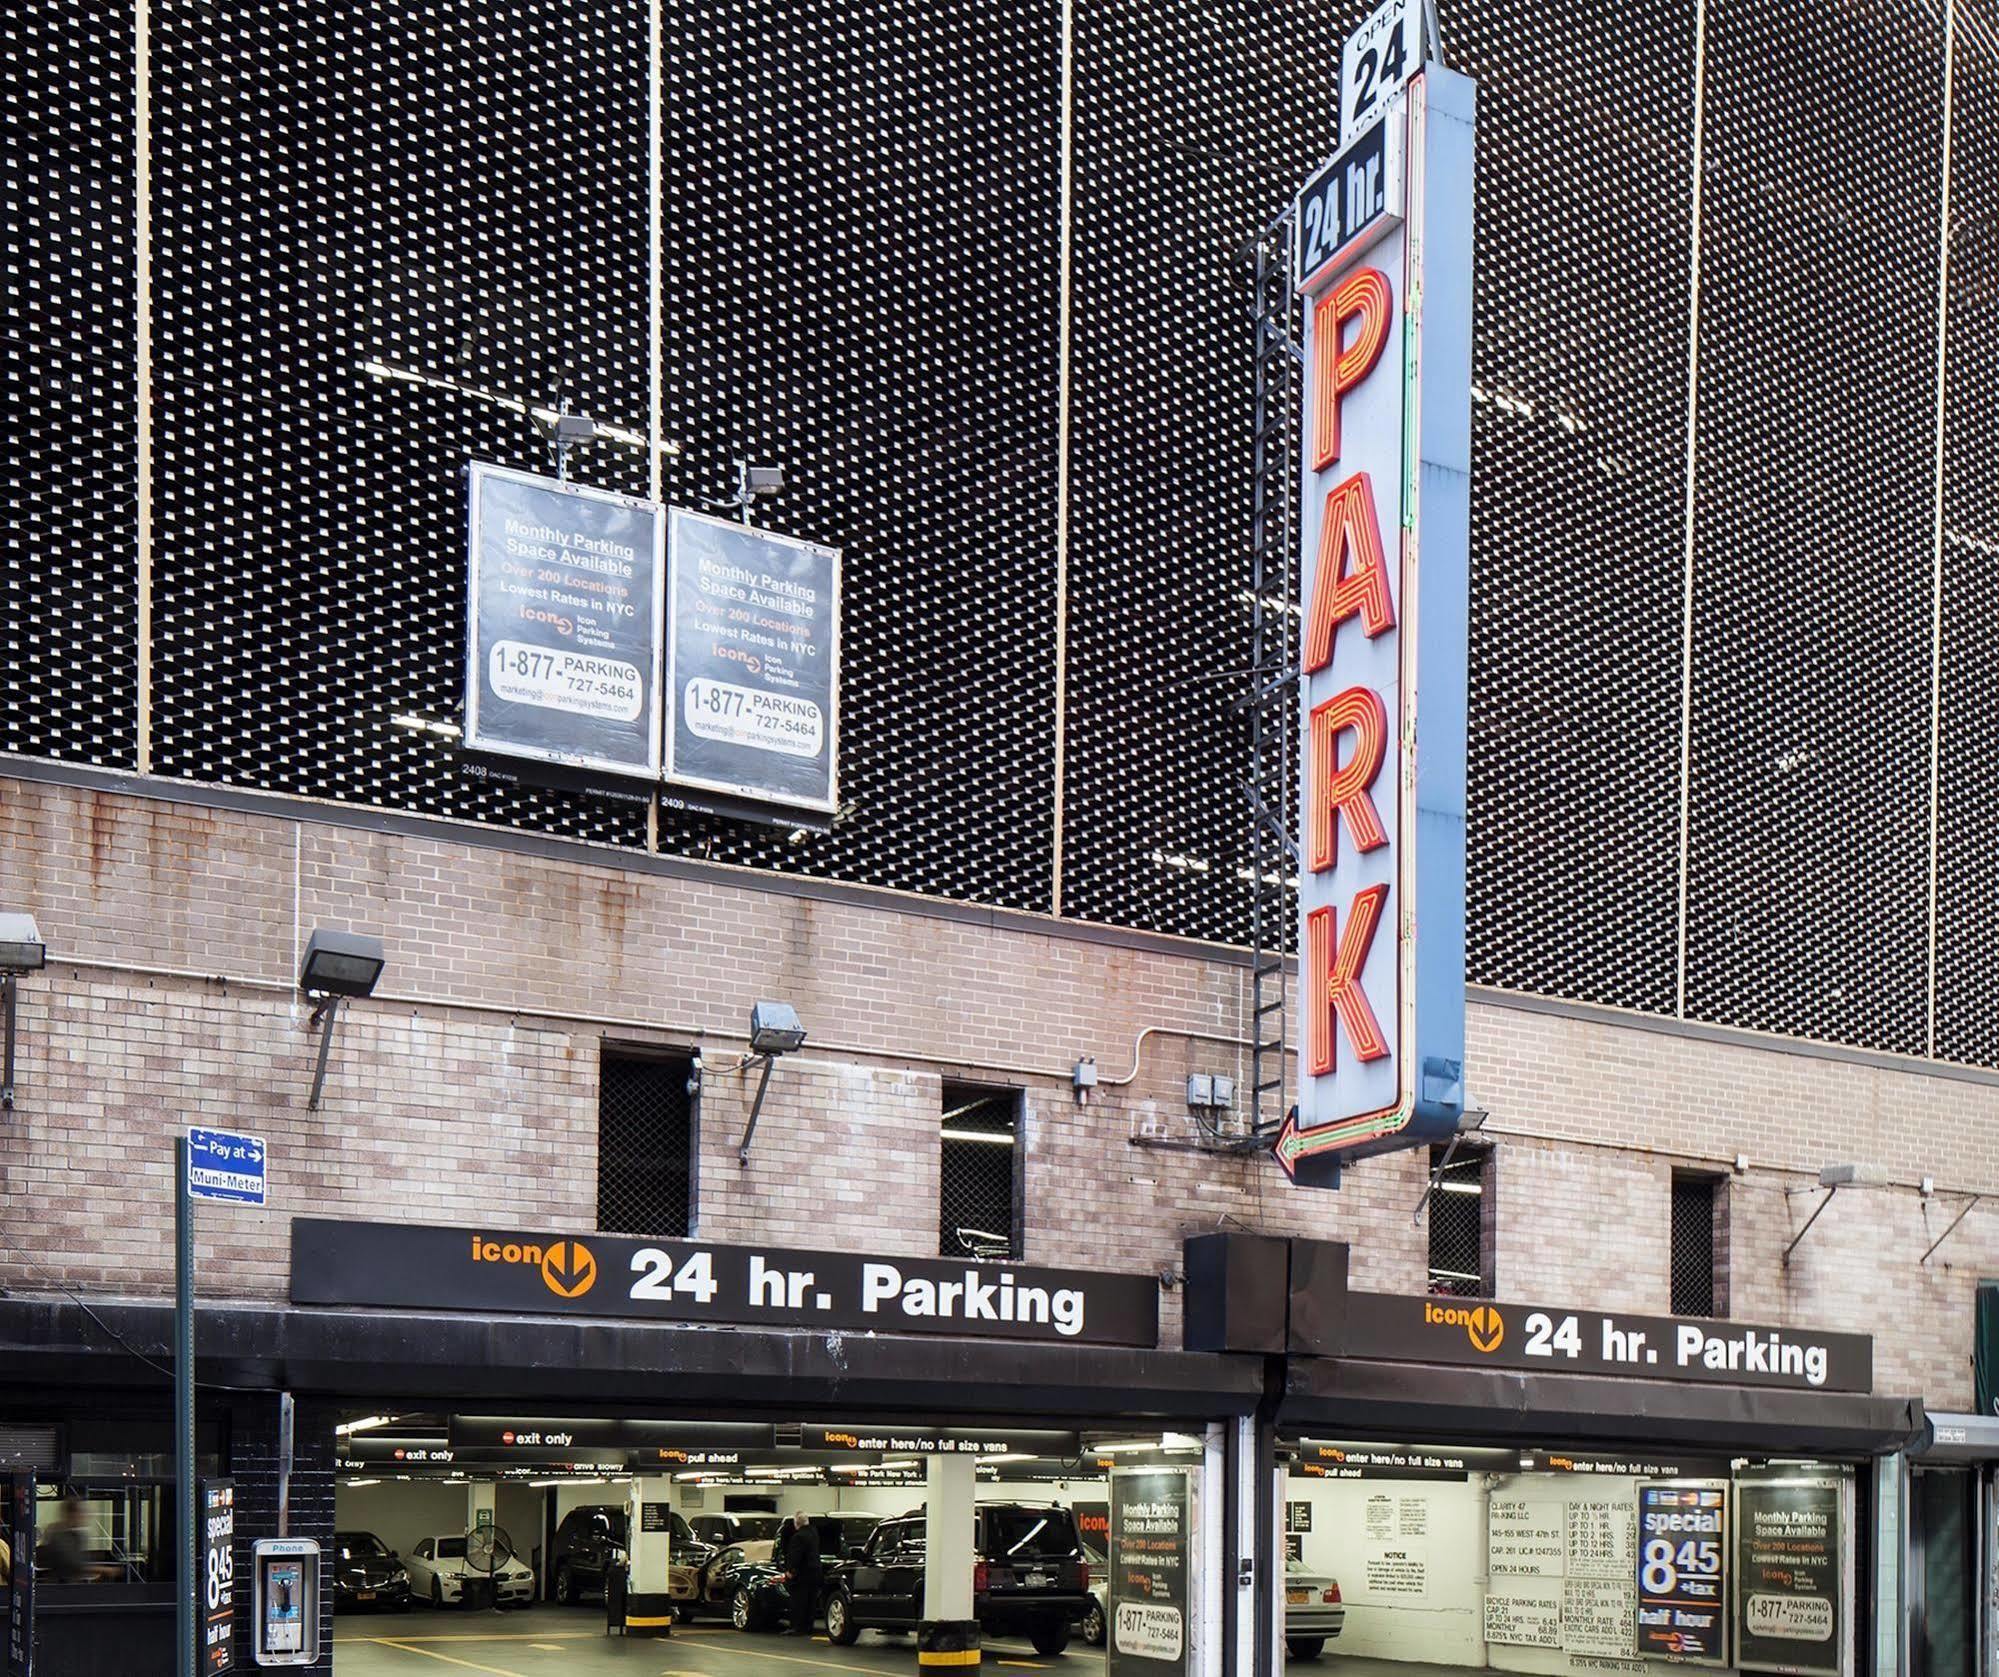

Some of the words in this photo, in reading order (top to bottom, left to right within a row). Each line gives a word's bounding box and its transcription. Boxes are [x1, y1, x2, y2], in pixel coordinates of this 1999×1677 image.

[1357, 0, 1406, 51] OPEN
[1353, 17, 1408, 122] 24
[1305, 177, 1341, 272] 24
[1346, 152, 1383, 236] hr.
[505, 519, 570, 547] Monthly
[574, 533, 635, 560] Parking
[507, 538, 556, 560] Space
[560, 549, 633, 577] Available
[501, 561, 534, 578] Over
[537, 568, 560, 583] 200
[564, 575, 629, 597] Locations
[699, 558, 758, 587] Monthly
[761, 573, 816, 603] Parking
[500, 579, 548, 601] Lowest
[551, 589, 588, 608] Rates
[591, 598, 603, 611] in
[606, 601, 635, 617] NYC
[700, 576, 746, 598] Space
[749, 589, 814, 618] Available
[519, 604, 558, 624] icon
[695, 600, 725, 617] Over
[728, 607, 750, 623] 200
[753, 614, 811, 637] Locations
[576, 634, 616, 650] Systems
[577, 625, 610, 639] Parking
[694, 618, 739, 640] Lowest
[741, 629, 775, 647] Rates
[777, 637, 788, 650] in
[790, 641, 816, 657] NYC
[712, 642, 748, 661] icon
[497, 646, 563, 680] 1-877-
[564, 657, 637, 682] PARKING
[764, 663, 794, 678] Parking
[1302, 265, 1397, 1078] PARK
[568, 676, 635, 700] 727-5464
[691, 683, 752, 717] 1-877-
[753, 695, 818, 719] PARKING
[756, 714, 816, 737] 727-5464
[462, 763, 488, 777] 2408
[209, 1140, 231, 1160] Pay
[233, 1146, 246, 1159] at
[471, 1235, 542, 1264] icon
[629, 1247, 718, 1304] 24
[749, 1254, 832, 1311] hr.
[861, 1262, 1085, 1337] Parking
[1425, 1302, 1470, 1326] icon
[1523, 1312, 1582, 1359] 24
[1602, 1319, 1658, 1364] hr.
[1676, 1324, 1828, 1387] Parking
[516, 1432, 541, 1445] exit
[545, 1432, 573, 1447] only
[825, 1432, 848, 1442] icon
[858, 1438, 888, 1450] enter
[891, 1437, 935, 1451] here/no
[938, 1439, 955, 1450] full
[959, 1440, 980, 1451] size
[983, 1442, 1008, 1452] vans
[405, 1450, 427, 1460] exit
[430, 1450, 454, 1462] only
[659, 1449, 680, 1460] icon
[688, 1453, 705, 1464] pull
[708, 1453, 738, 1463] ahead
[1319, 1447, 1338, 1458] icon
[1346, 1454, 1368, 1464] enter
[1371, 1453, 1406, 1466] here/no
[1408, 1456, 1422, 1466] full
[1424, 1457, 1441, 1467] size
[1444, 1459, 1464, 1469] vans
[1324, 1468, 1337, 1478] pull
[1339, 1468, 1362, 1477] ahead
[1573, 1462, 1595, 1472] enter
[1629, 1463, 1641, 1473] full
[1611, 1503, 1634, 1512] RATES
[207, 1507, 234, 1543] special
[1080, 1513, 1108, 1530] icon
[1644, 1509, 1722, 1535] special
[1754, 1511, 1790, 1525] Monthly
[1791, 1511, 1828, 1526] Parking
[1755, 1524, 1783, 1537] Space
[1784, 1524, 1827, 1537] Available
[272, 1544, 304, 1552] Phone
[1384, 1551, 1407, 1560] NOTICE
[1811, 1556, 1828, 1566] NYC
[1787, 1600, 1829, 1612] PARKING
[1146, 1609, 1180, 1625] PARKING
[1510, 1633, 1523, 1642] NYC
